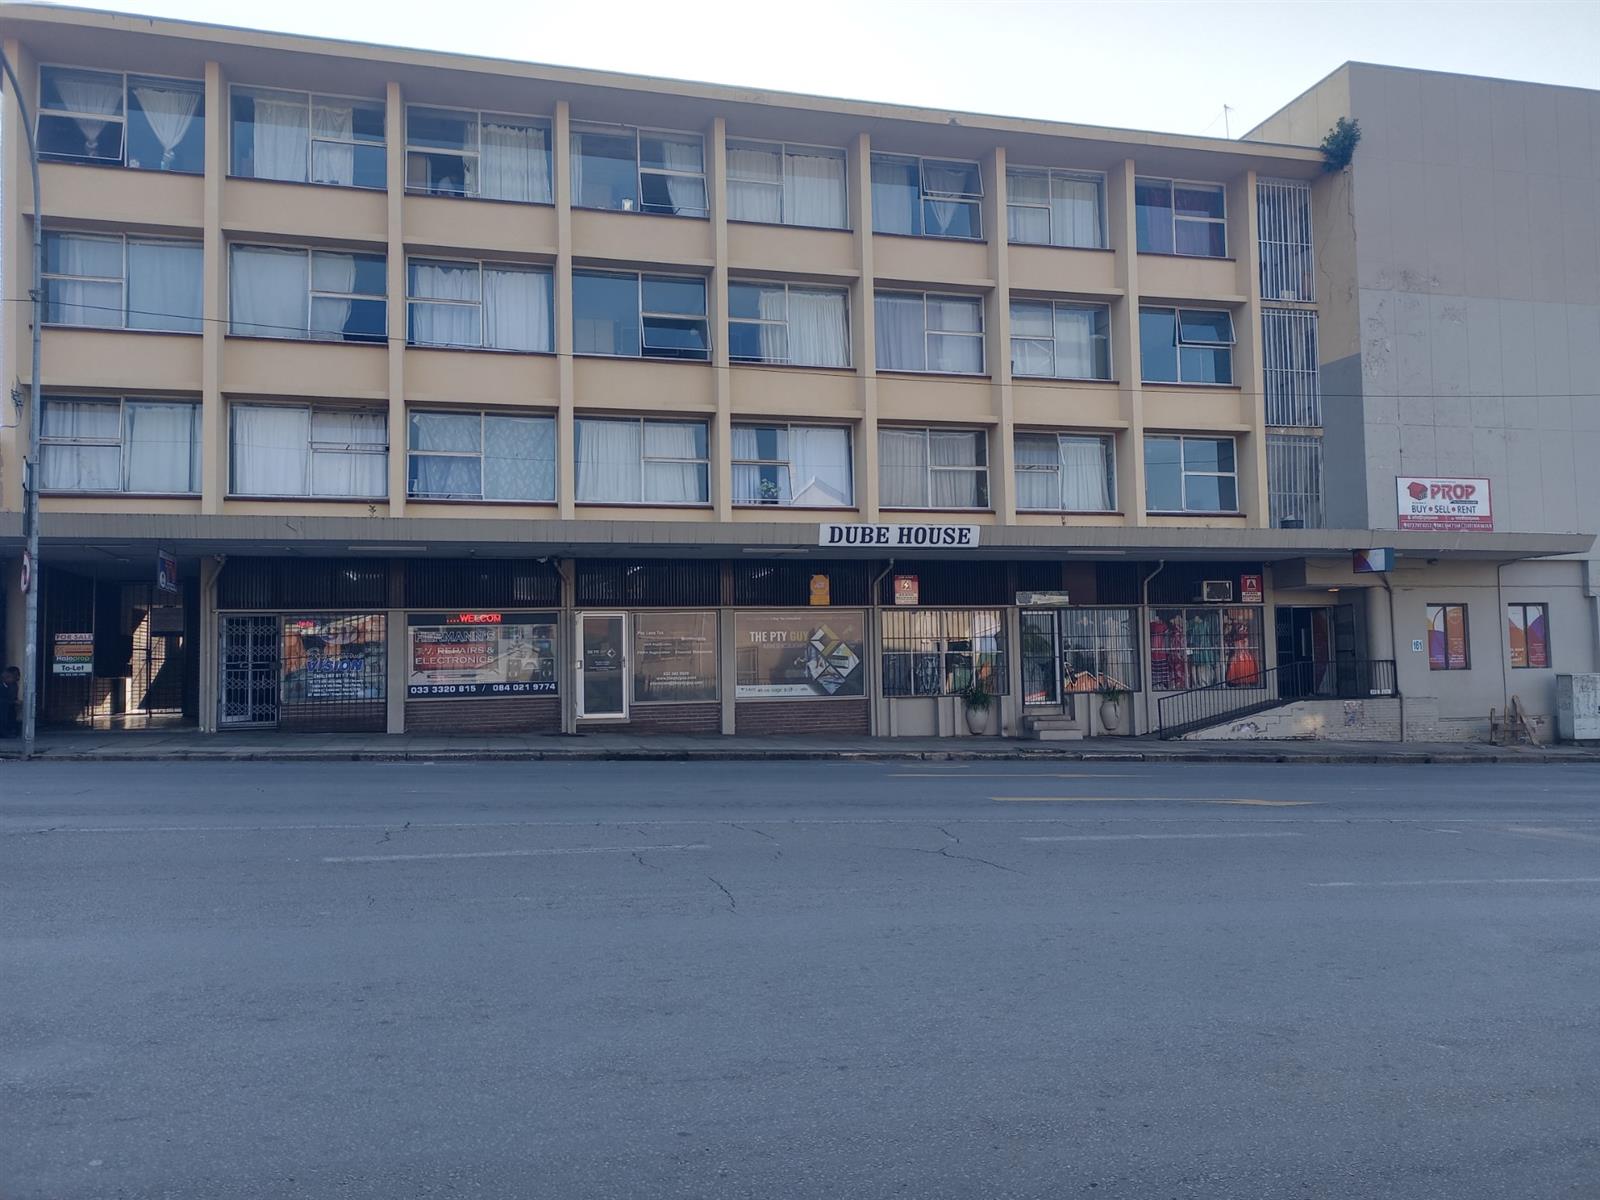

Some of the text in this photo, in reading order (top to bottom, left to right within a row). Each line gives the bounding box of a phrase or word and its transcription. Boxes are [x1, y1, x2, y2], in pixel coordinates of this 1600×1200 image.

[1430, 484, 1476, 500] PROP
[1412, 505, 1476, 514] BUY SELL RENT
[828, 526, 972, 544] DUBE HOUSE
[749, 631, 808, 642] THE PTY GUY
[438, 646, 484, 654] REPAIRS
[416, 655, 494, 664] ELECTRONICS
[307, 659, 364, 672] VISION
